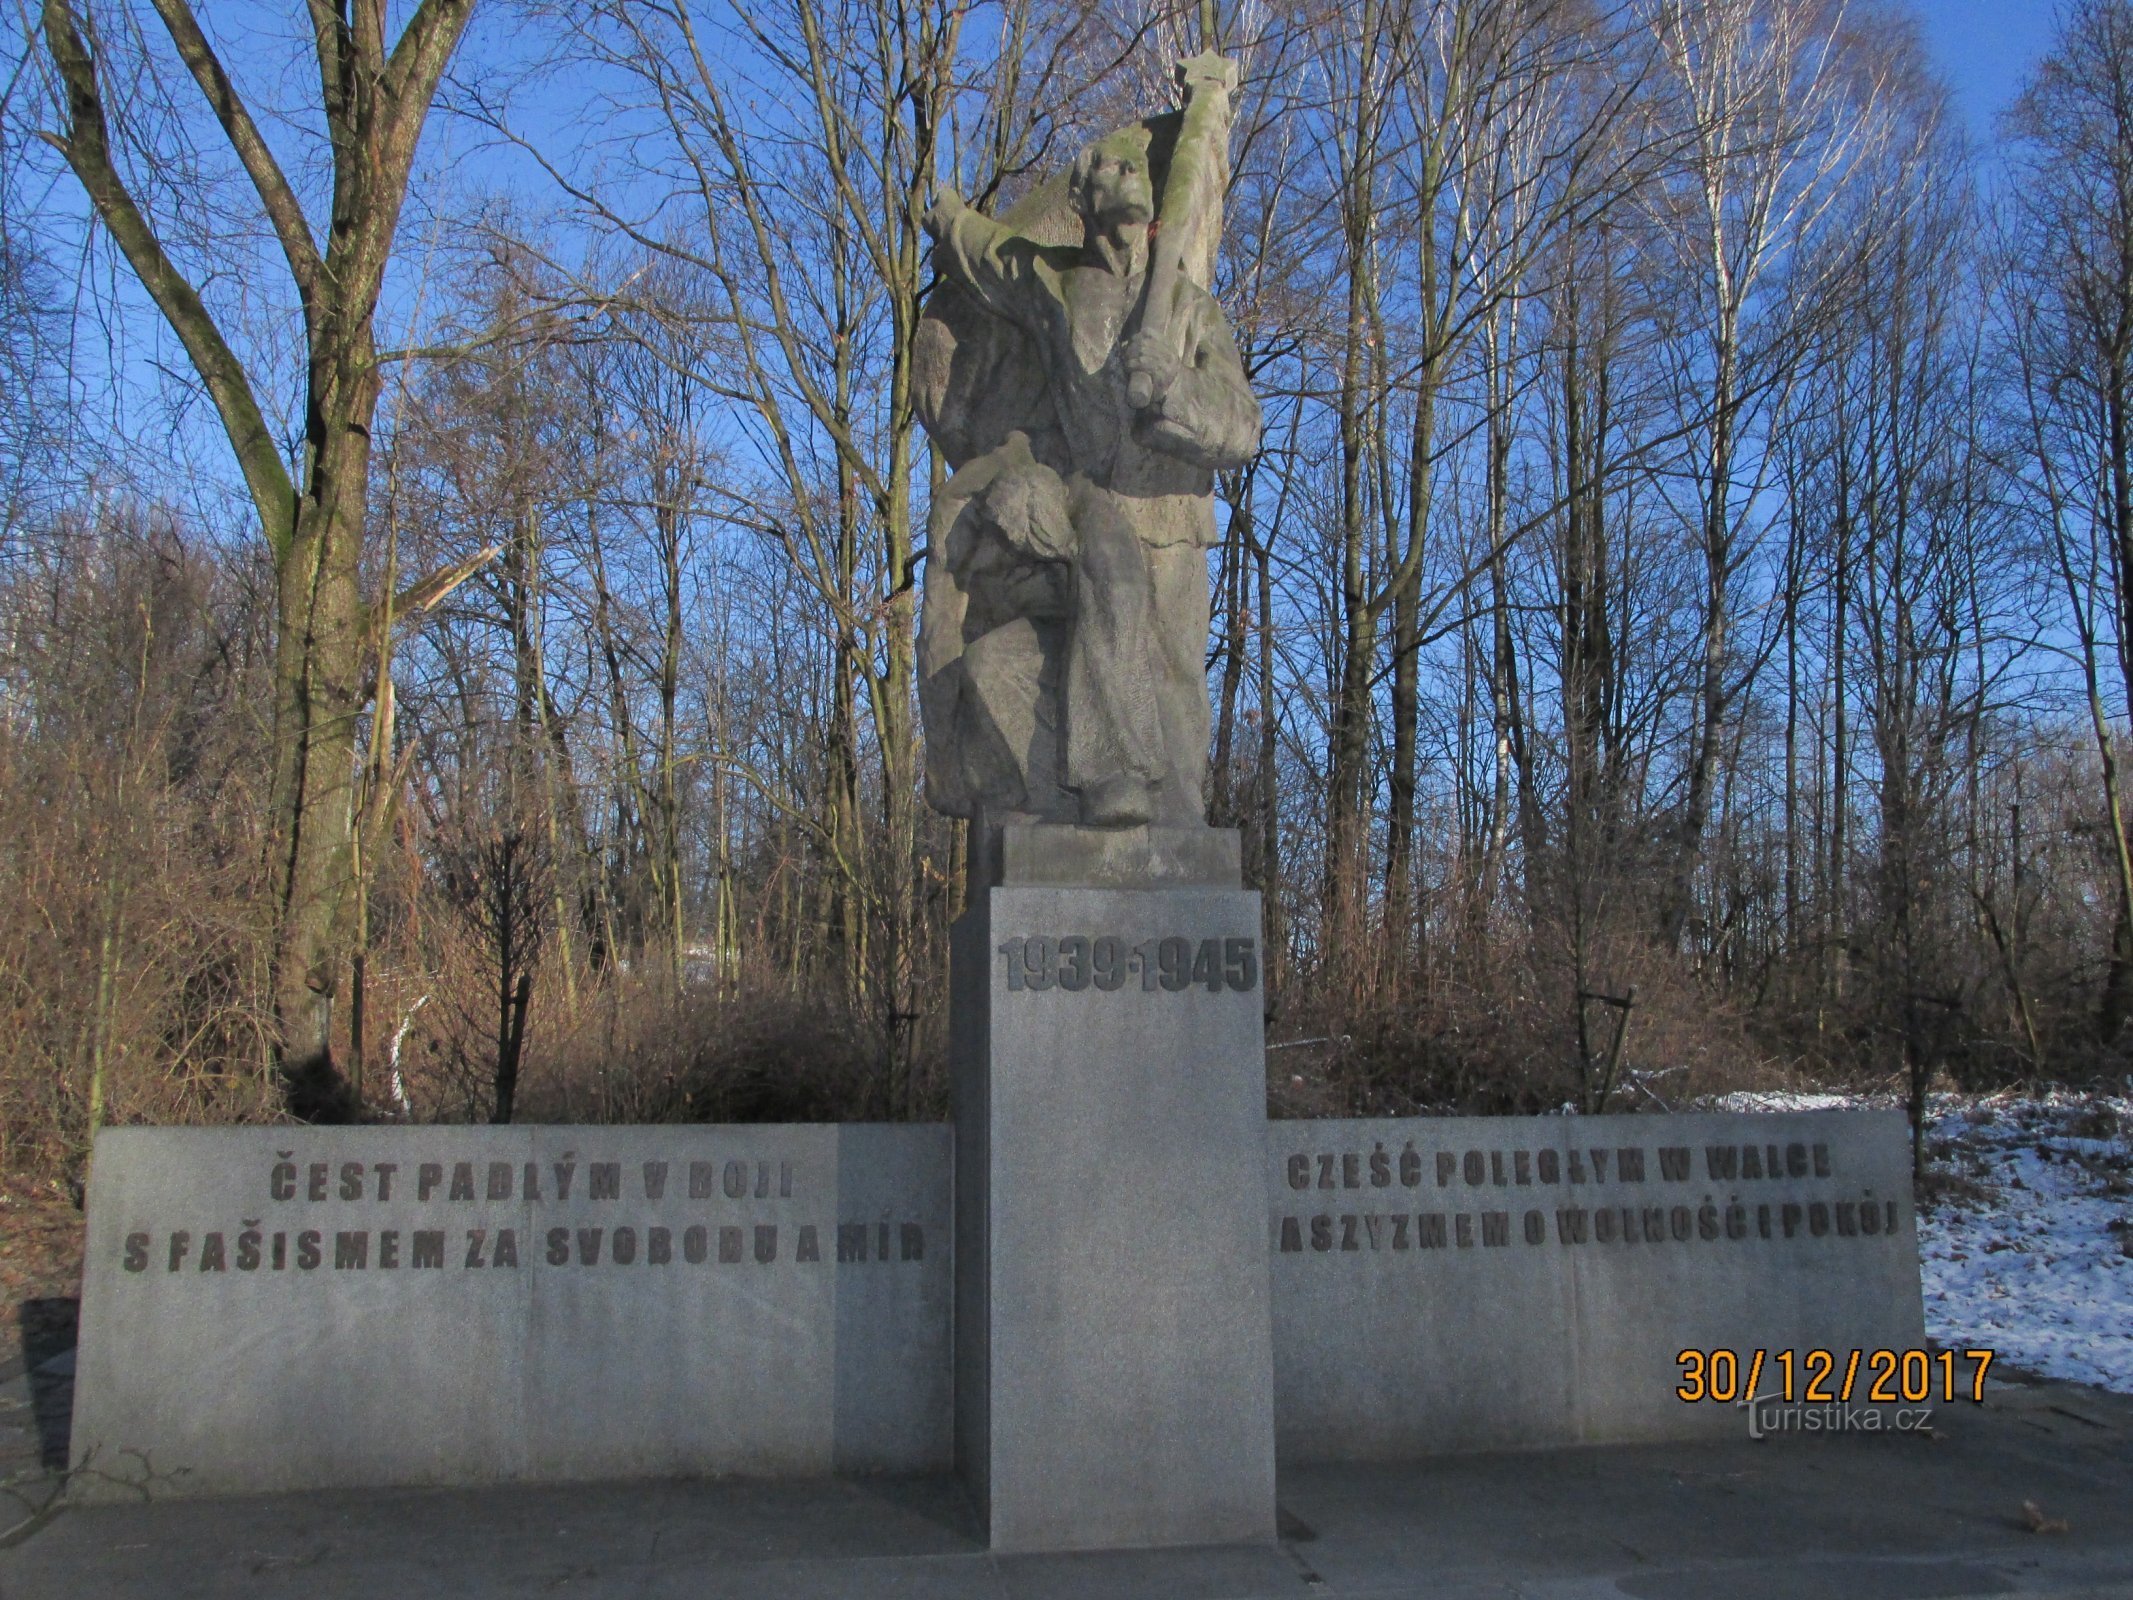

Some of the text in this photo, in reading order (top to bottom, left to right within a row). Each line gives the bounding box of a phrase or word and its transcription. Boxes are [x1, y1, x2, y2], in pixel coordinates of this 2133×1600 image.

[270, 1150, 793, 1201] ČEST PADLÝM V BOJI
[1287, 1140, 1831, 1190] CZEŚĆ POLEGŁYM W WALCE
[123, 1208, 925, 1273] S FAŠISMEM ZA SVOBODU A MÍR
[1280, 1187, 1898, 1253] ASZYZMEM O WOLNOŚĆ I POKÓJ
